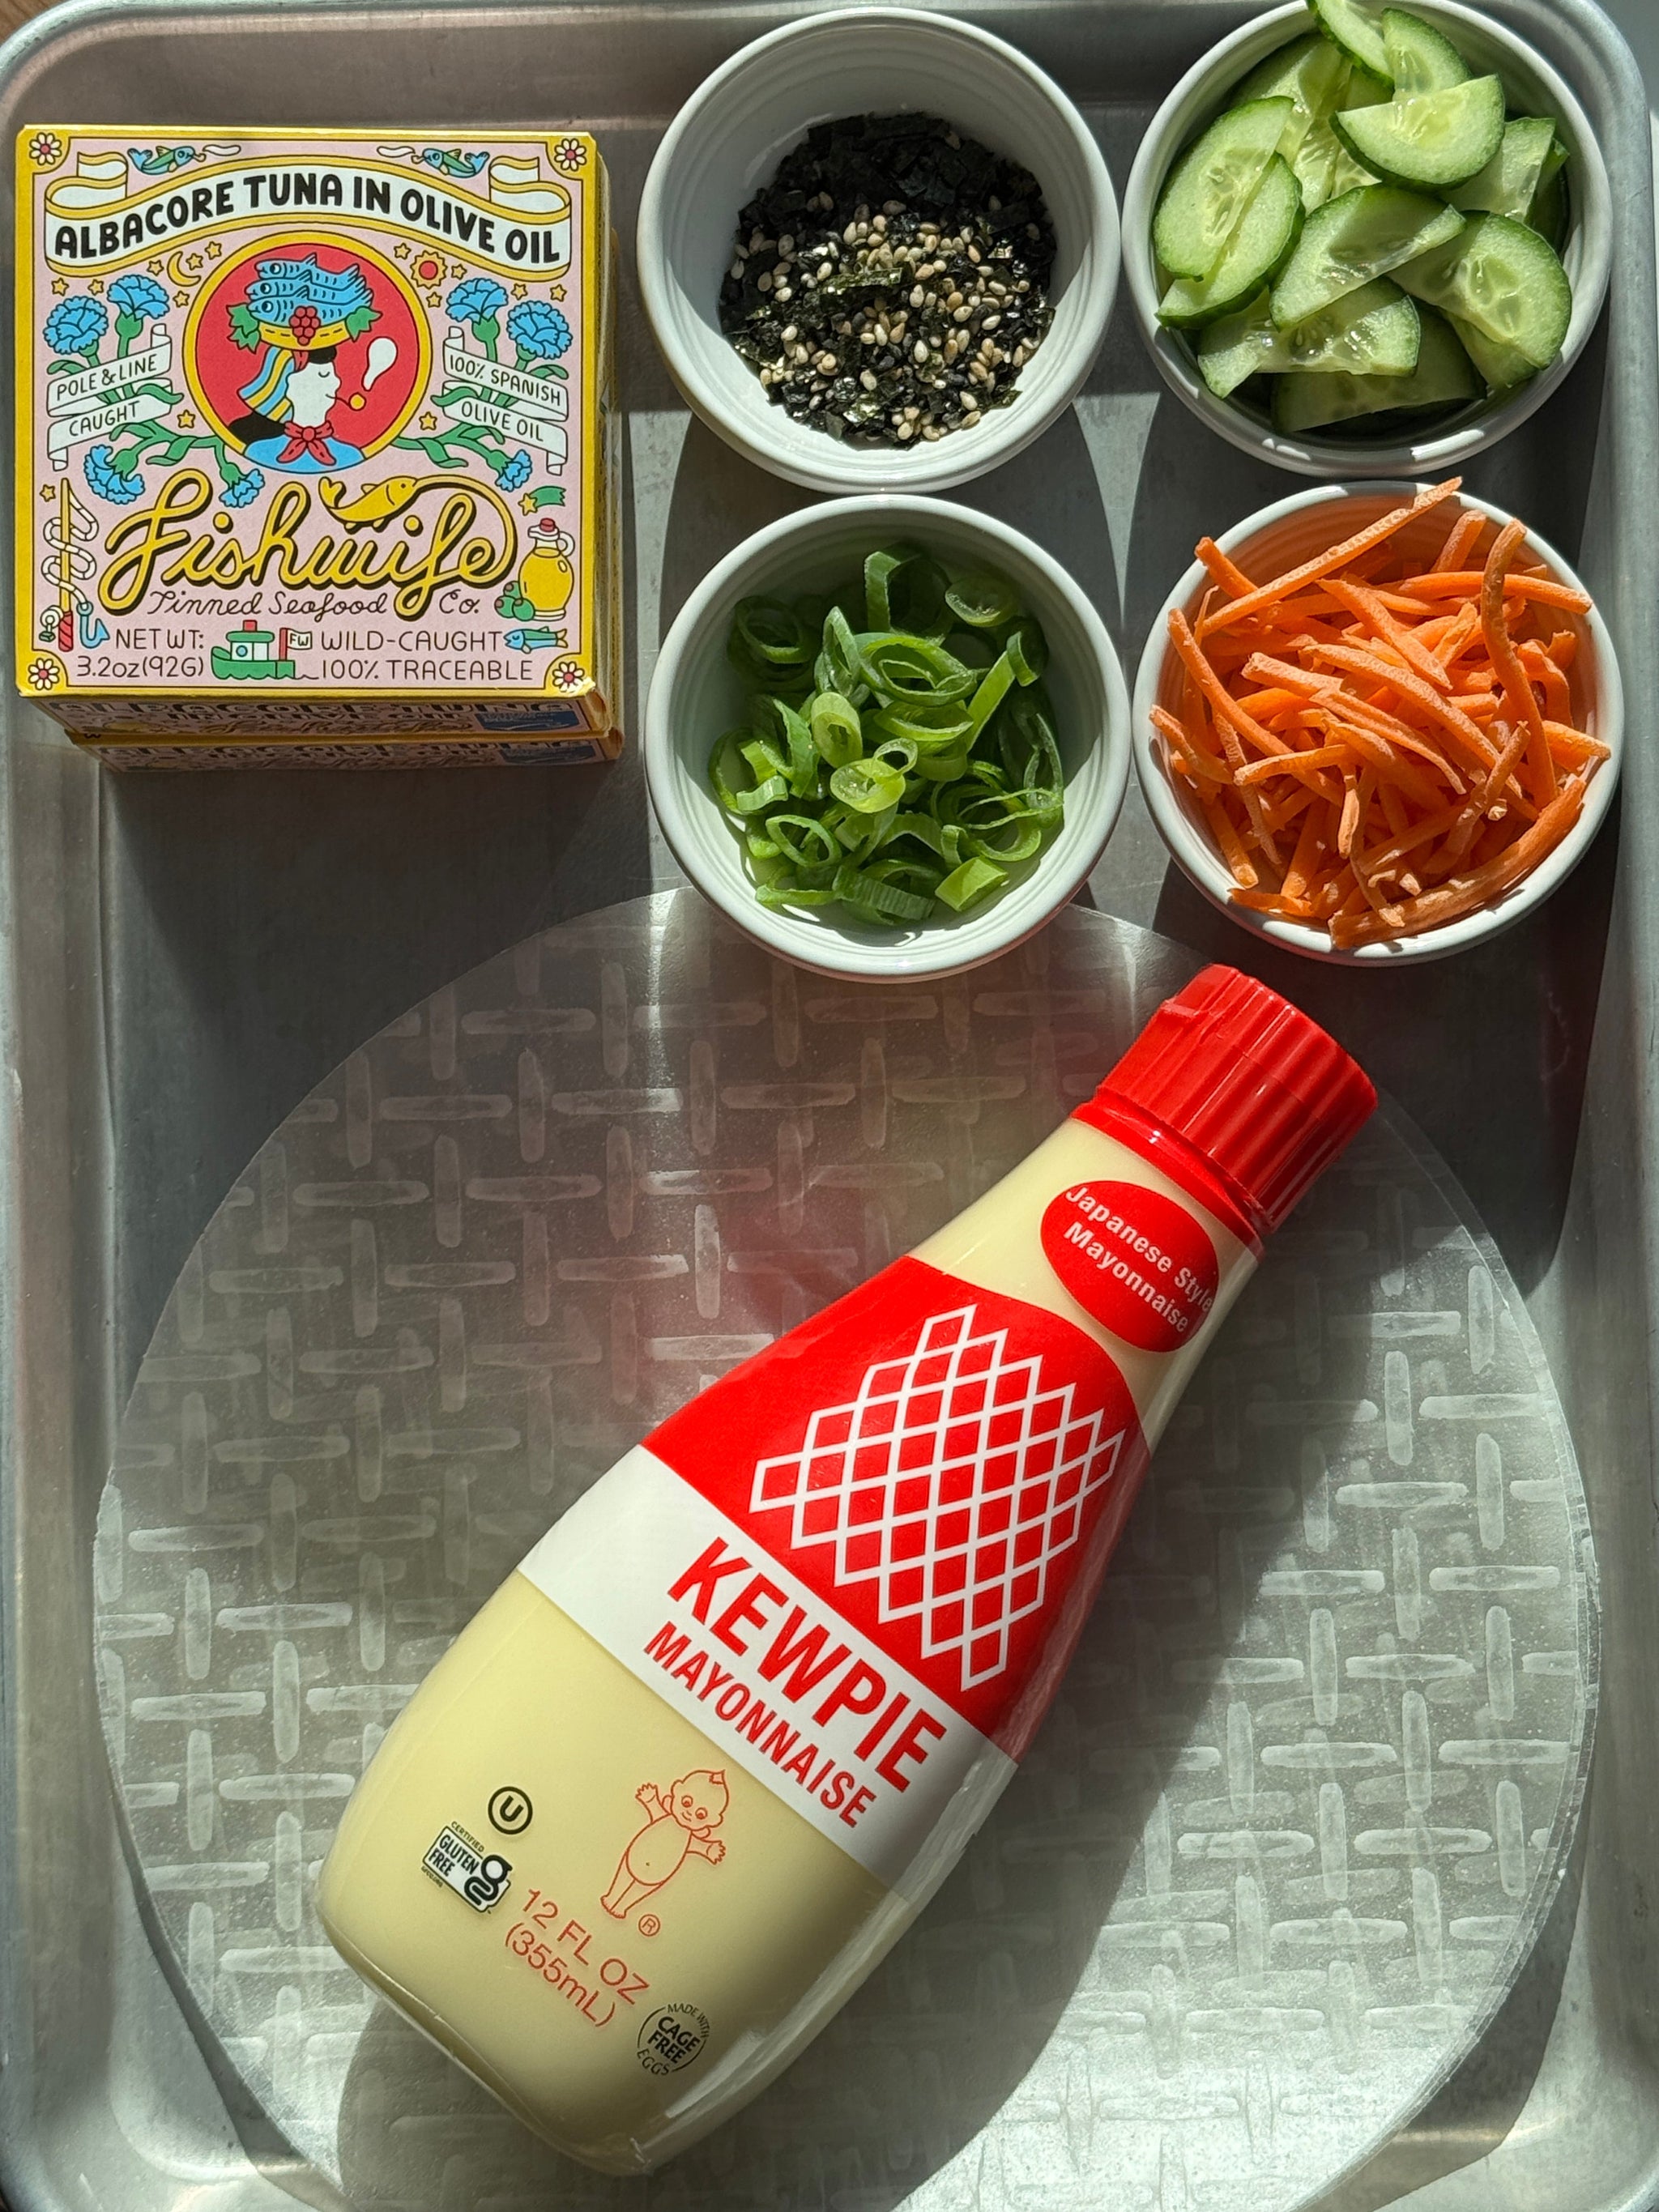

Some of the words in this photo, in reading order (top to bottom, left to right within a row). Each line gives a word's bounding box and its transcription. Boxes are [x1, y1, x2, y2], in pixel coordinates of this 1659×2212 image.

[54, 181, 234, 259] ALBACORE
[243, 173, 343, 208] TUNA
[353, 177, 392, 214] IN
[399, 188, 496, 254] OLIVE
[505, 228, 561, 264] OIL
[57, 373, 97, 401] POLE
[101, 369, 117, 386] &
[119, 354, 157, 380] LINE
[450, 354, 486, 380] 100%
[491, 369, 561, 407] SPANISH
[69, 400, 140, 437] CAUGHT
[461, 401, 512, 430] OLIVE
[516, 419, 544, 442] OIL
[97, 470, 520, 620] Fishwife
[147, 590, 262, 616] Tinned
[268, 590, 387, 622] Seafood
[439, 590, 480, 614] Co.
[116, 629, 161, 650] NET
[167, 629, 204, 650] WT:
[289, 633, 309, 647] FW
[321, 630, 503, 651] WILD-CAUGHT
[322, 659, 379, 680] 100%
[386, 659, 533, 680] TRACEABLE
[1064, 1186, 1172, 1272] Japanese
[1174, 1267, 1213, 1313] Style
[1063, 1221, 1189, 1332] Mayonnaise
[667, 1536, 947, 1793] KEWPIE
[643, 1621, 876, 1828] MAYONNAISE
[439, 1834, 480, 1875] GLUTEN
[450, 1821, 484, 1853] CERTIFIED
[428, 1848, 455, 1877] FREE
[521, 1888, 559, 1930] 12
[557, 1919, 593, 1966] FL
[599, 1958, 650, 2005] OZ
[505, 1922, 616, 2027] (355mL)
[657, 2015, 702, 2052] CAGE
[667, 2002, 699, 2018] MADE
[696, 2012, 710, 2039] WITH
[636, 2048, 671, 2076] EGGS
[646, 2029, 688, 2065] FREE
